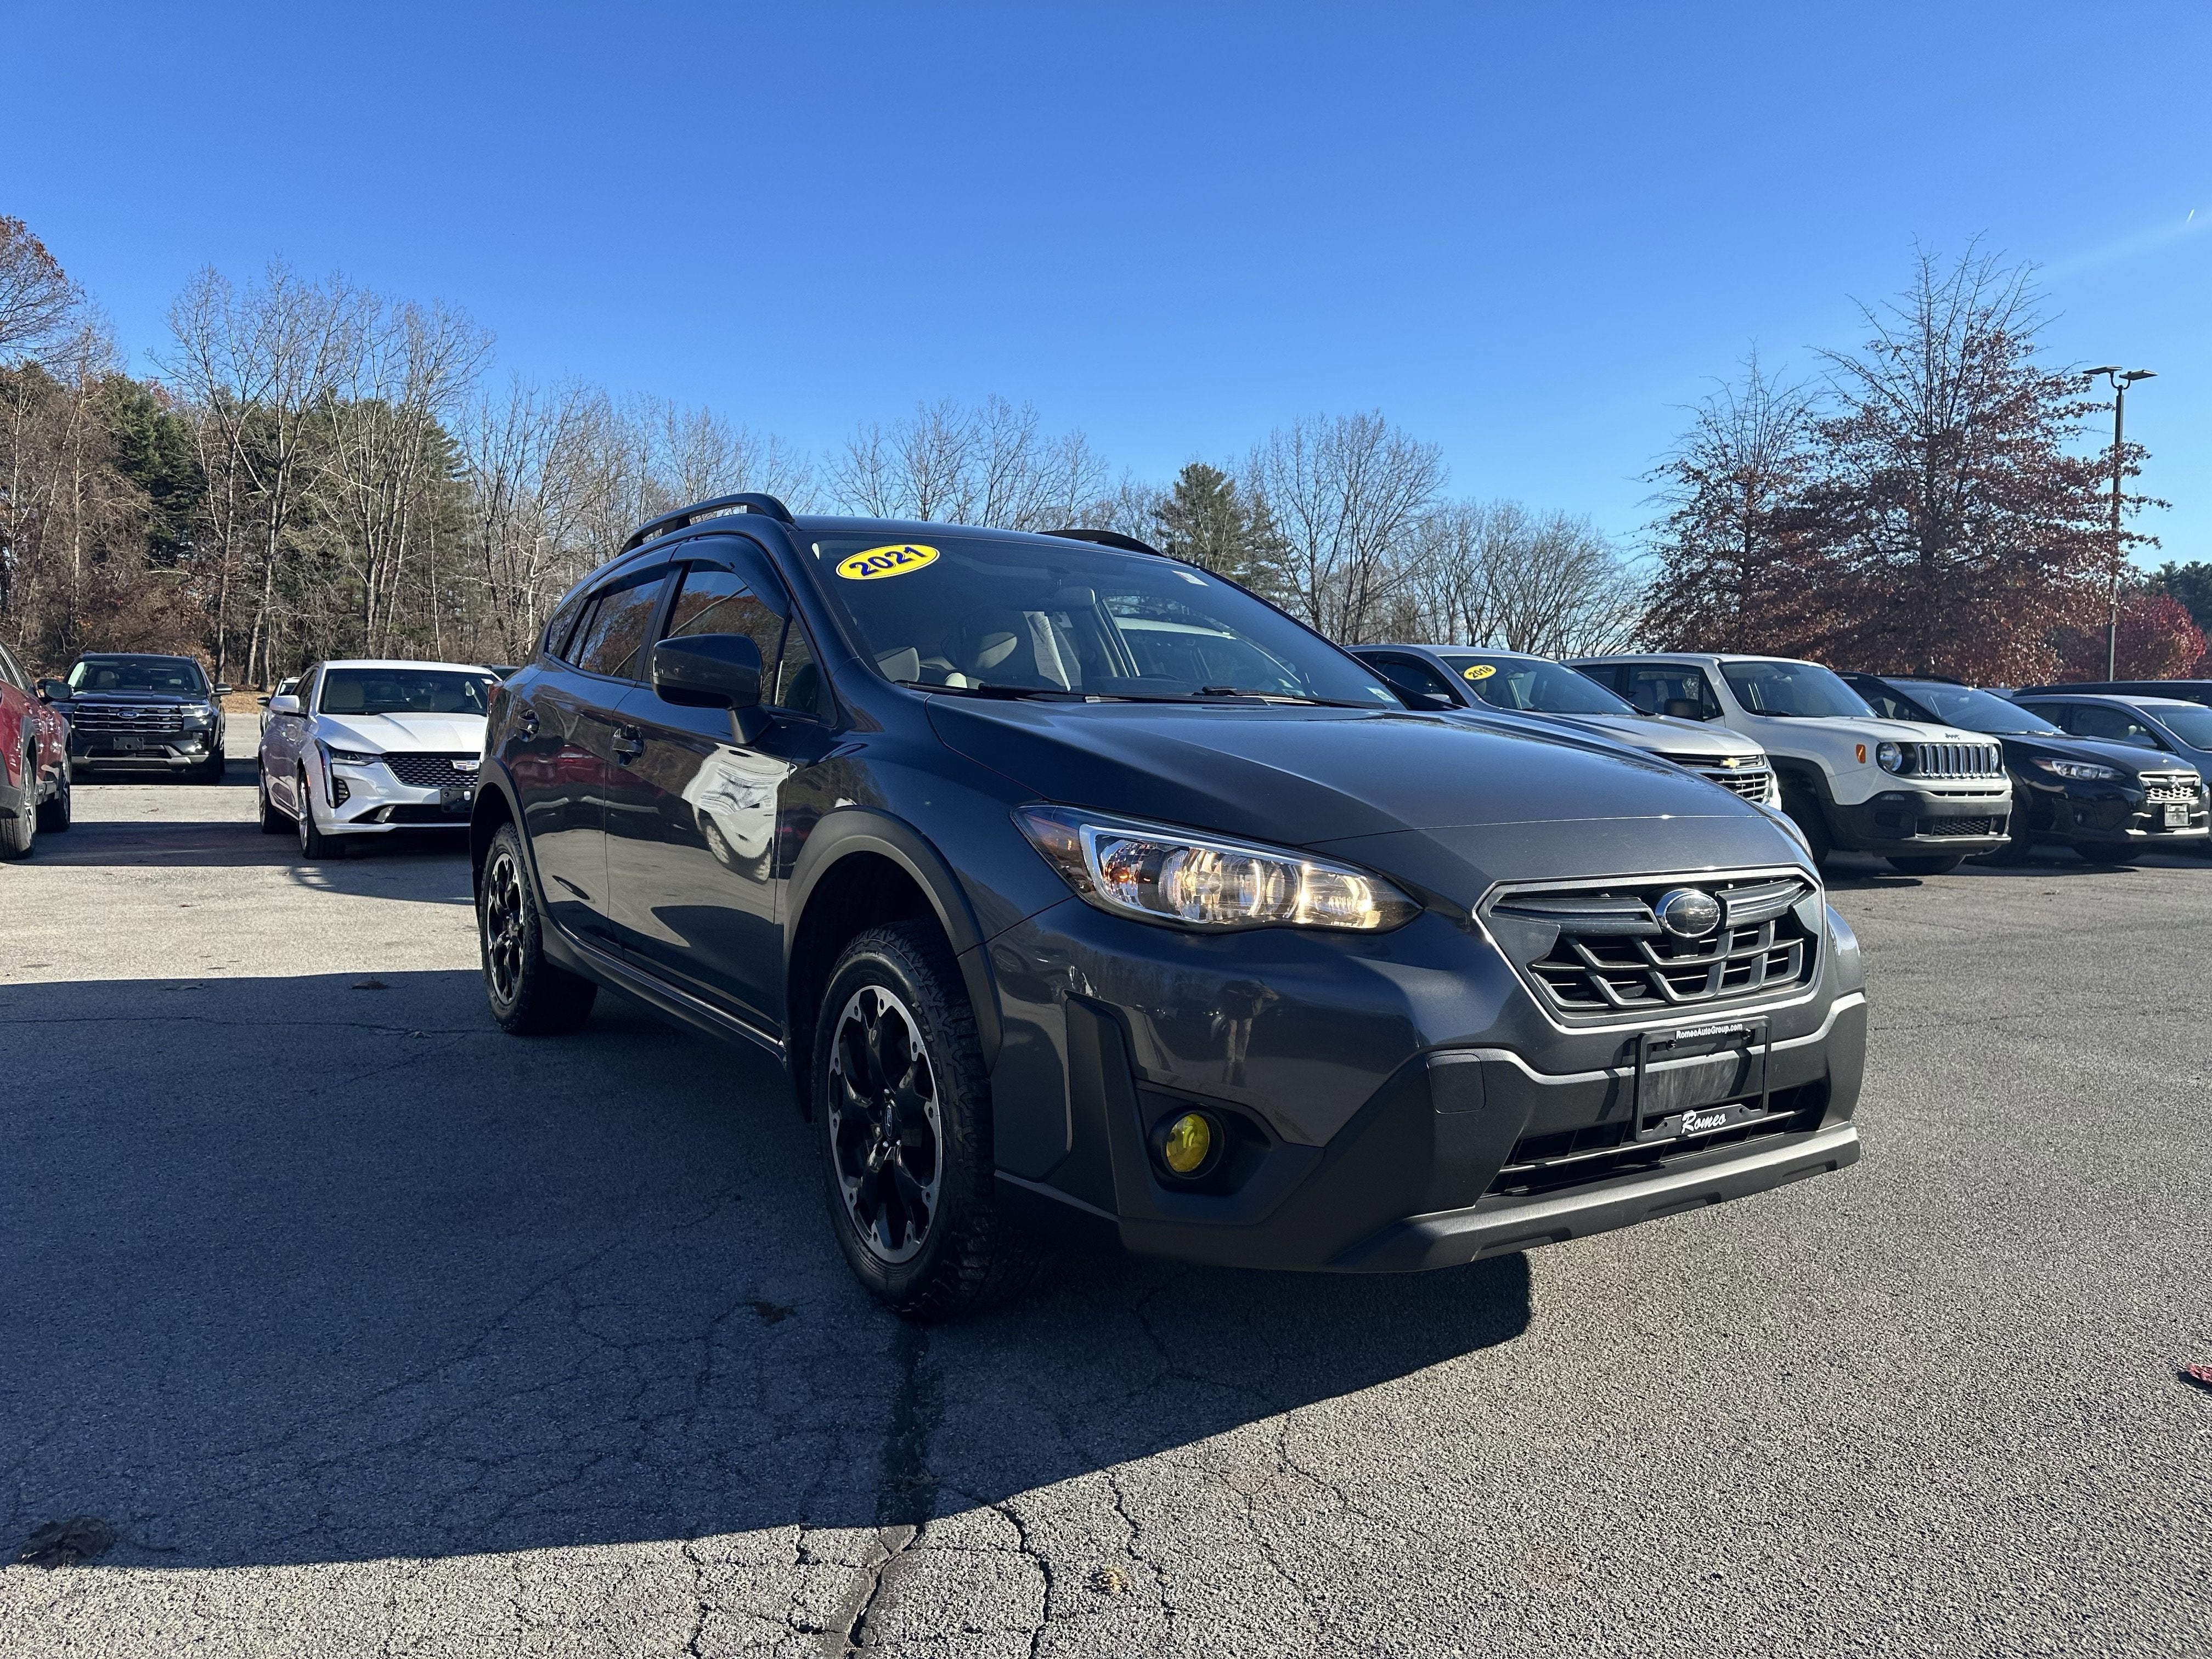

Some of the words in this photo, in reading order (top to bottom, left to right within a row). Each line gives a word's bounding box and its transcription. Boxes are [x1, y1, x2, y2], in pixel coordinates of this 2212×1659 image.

[849, 546, 928, 577] 2021
[1468, 666, 1492, 678] 2018
[1676, 1024, 1743, 1039] RomeoAutoGroup.com
[1681, 1110, 1726, 1134] Romeo
